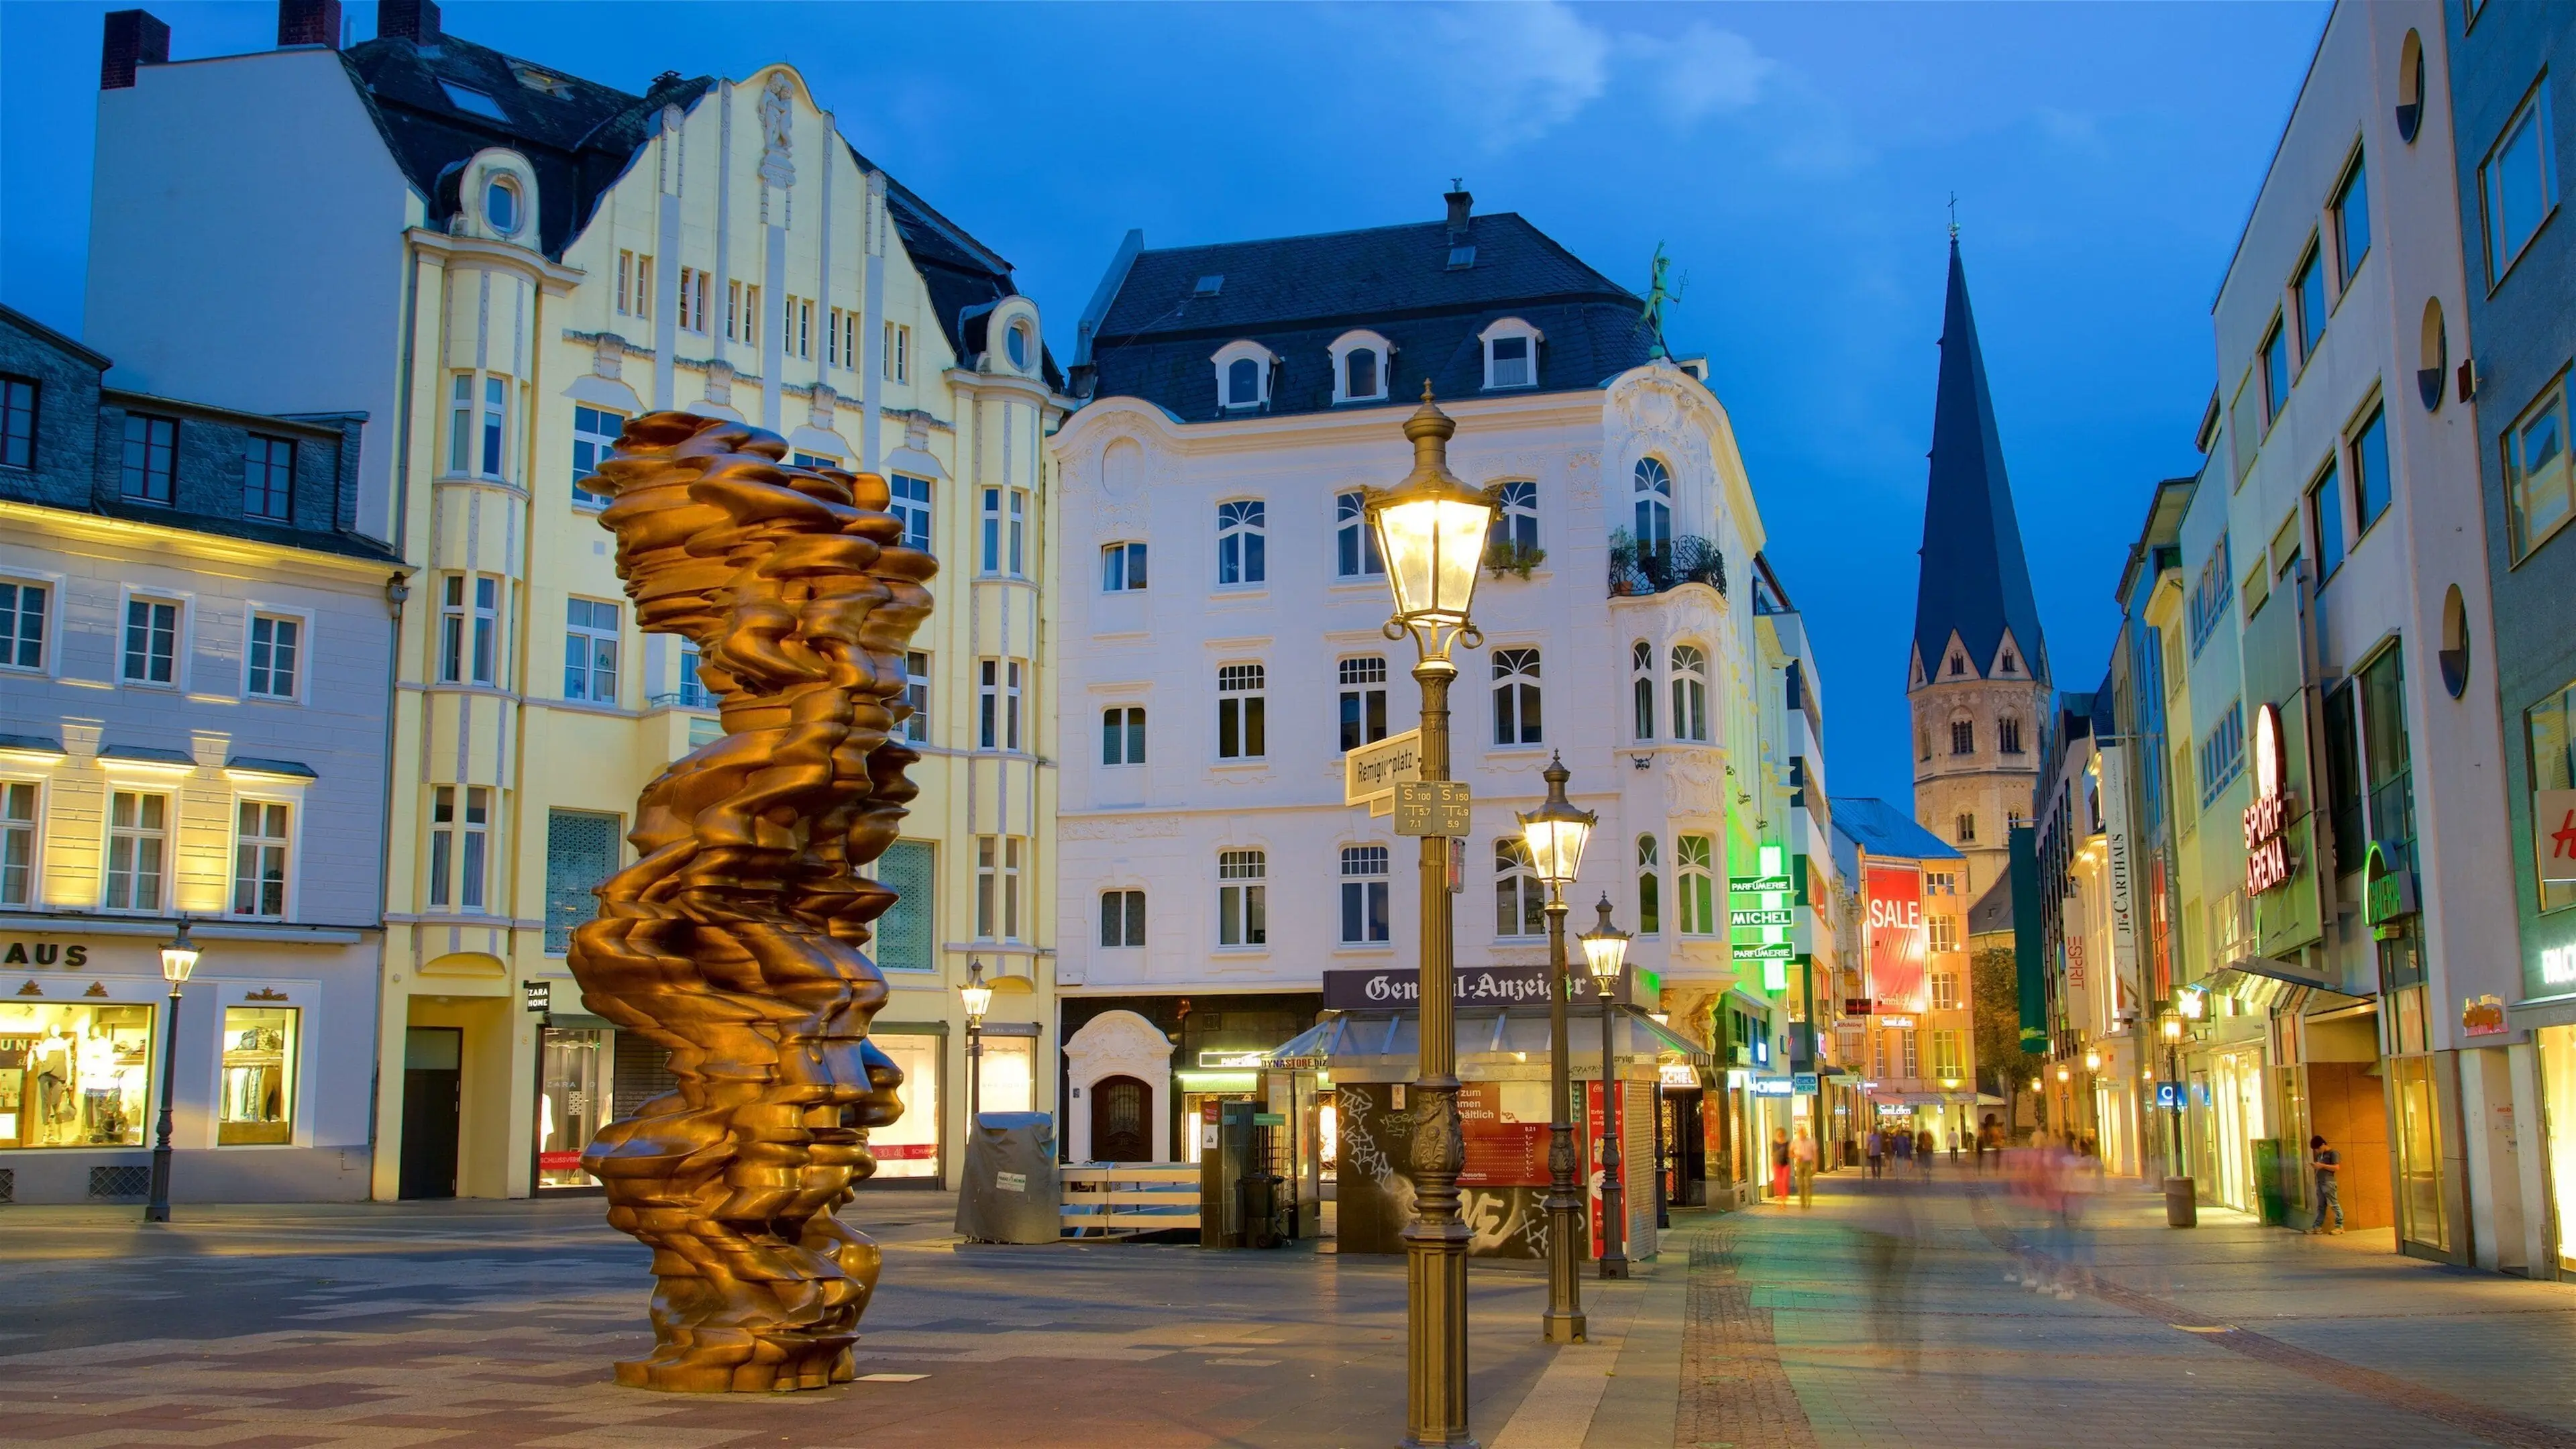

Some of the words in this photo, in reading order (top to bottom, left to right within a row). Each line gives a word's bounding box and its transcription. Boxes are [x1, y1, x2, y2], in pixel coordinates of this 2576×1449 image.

[1404, 788, 1413, 801] S
[1417, 792, 1431, 801] 100
[1442, 789, 1451, 801] S
[1455, 793, 1469, 802] 150
[2246, 836, 2286, 898] ARENA
[1731, 912, 1790, 925] MICHEL
[1871, 899, 1919, 929] SALE
[4, 943, 87, 966] AUS
[2068, 936, 2084, 991] ESPRIT
[528, 988, 549, 996] ZARA
[1364, 972, 1588, 1002] Genl-Anzeigr
[528, 999, 548, 1007] HOME
[1458, 1109, 1494, 1119] hältlich
